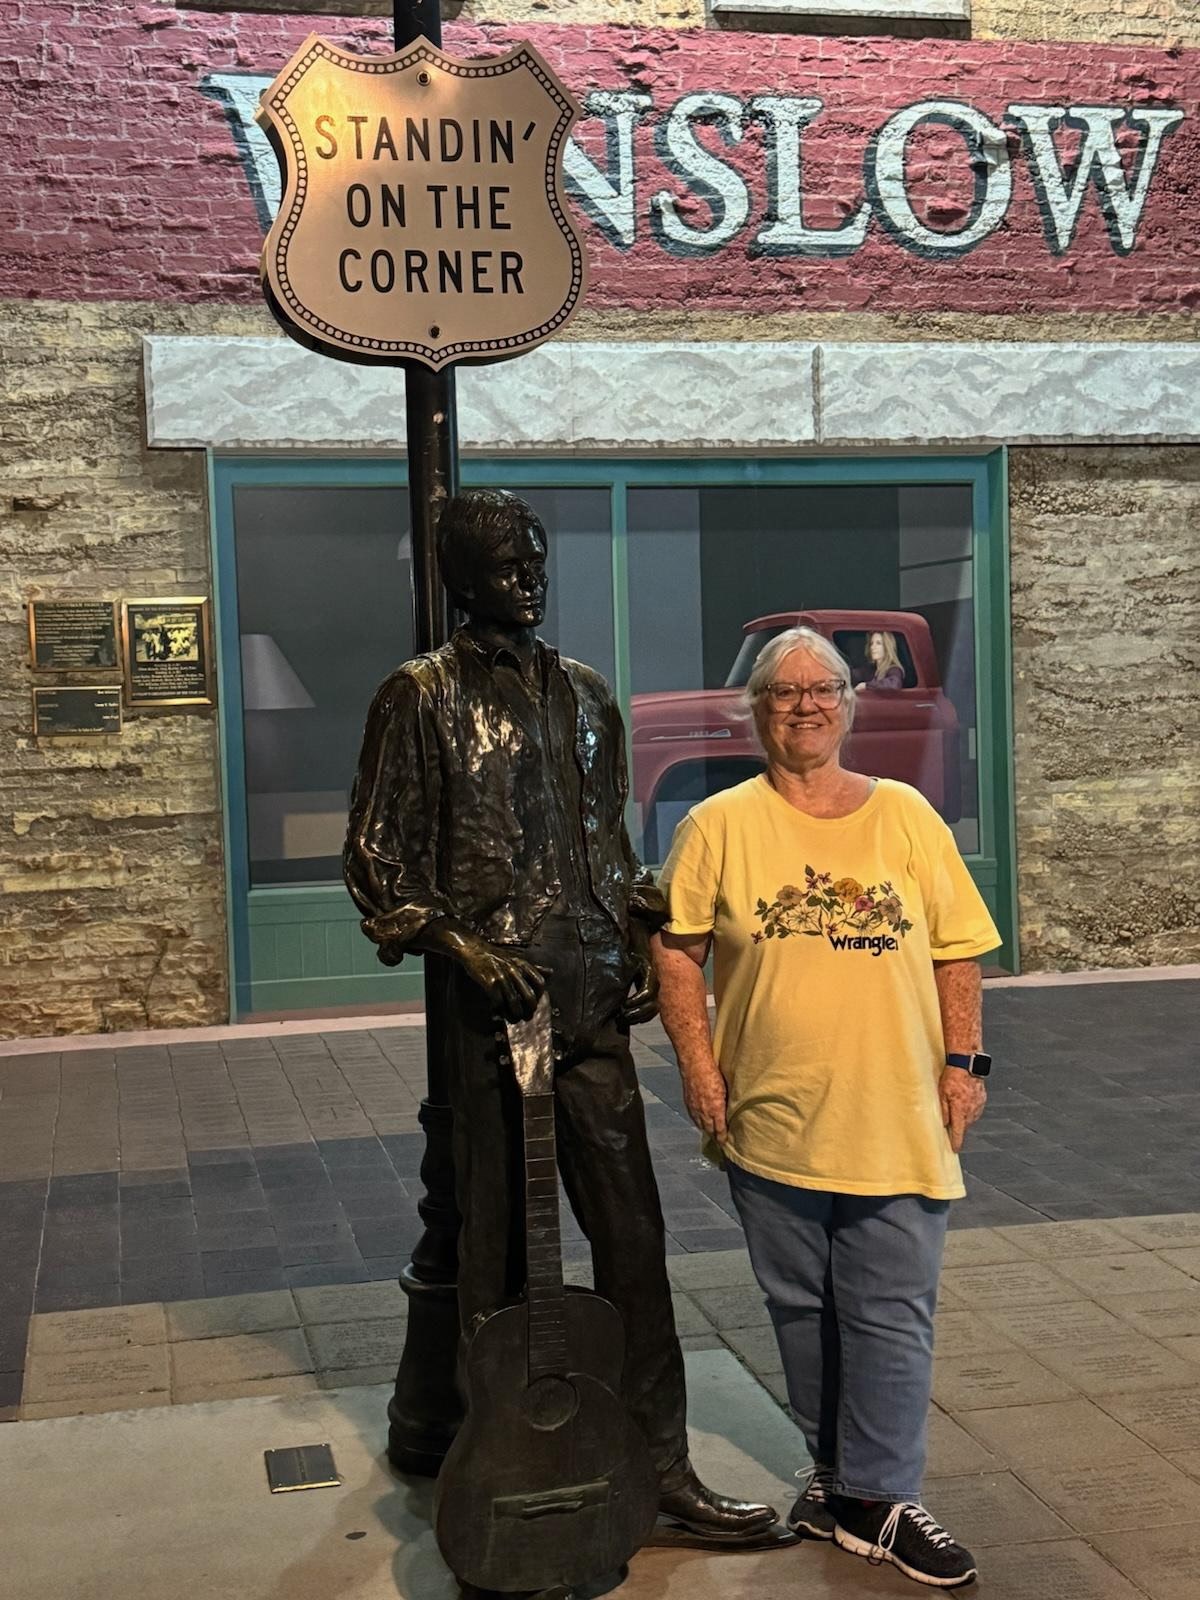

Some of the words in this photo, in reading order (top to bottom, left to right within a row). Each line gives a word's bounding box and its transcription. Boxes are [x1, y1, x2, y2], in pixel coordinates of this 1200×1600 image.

[314, 114, 537, 165] STANDIN'
[202, 72, 1184, 260] NSLOW
[346, 183, 406, 229] ON
[427, 185, 512, 230] THE
[338, 248, 524, 295] CORNER
